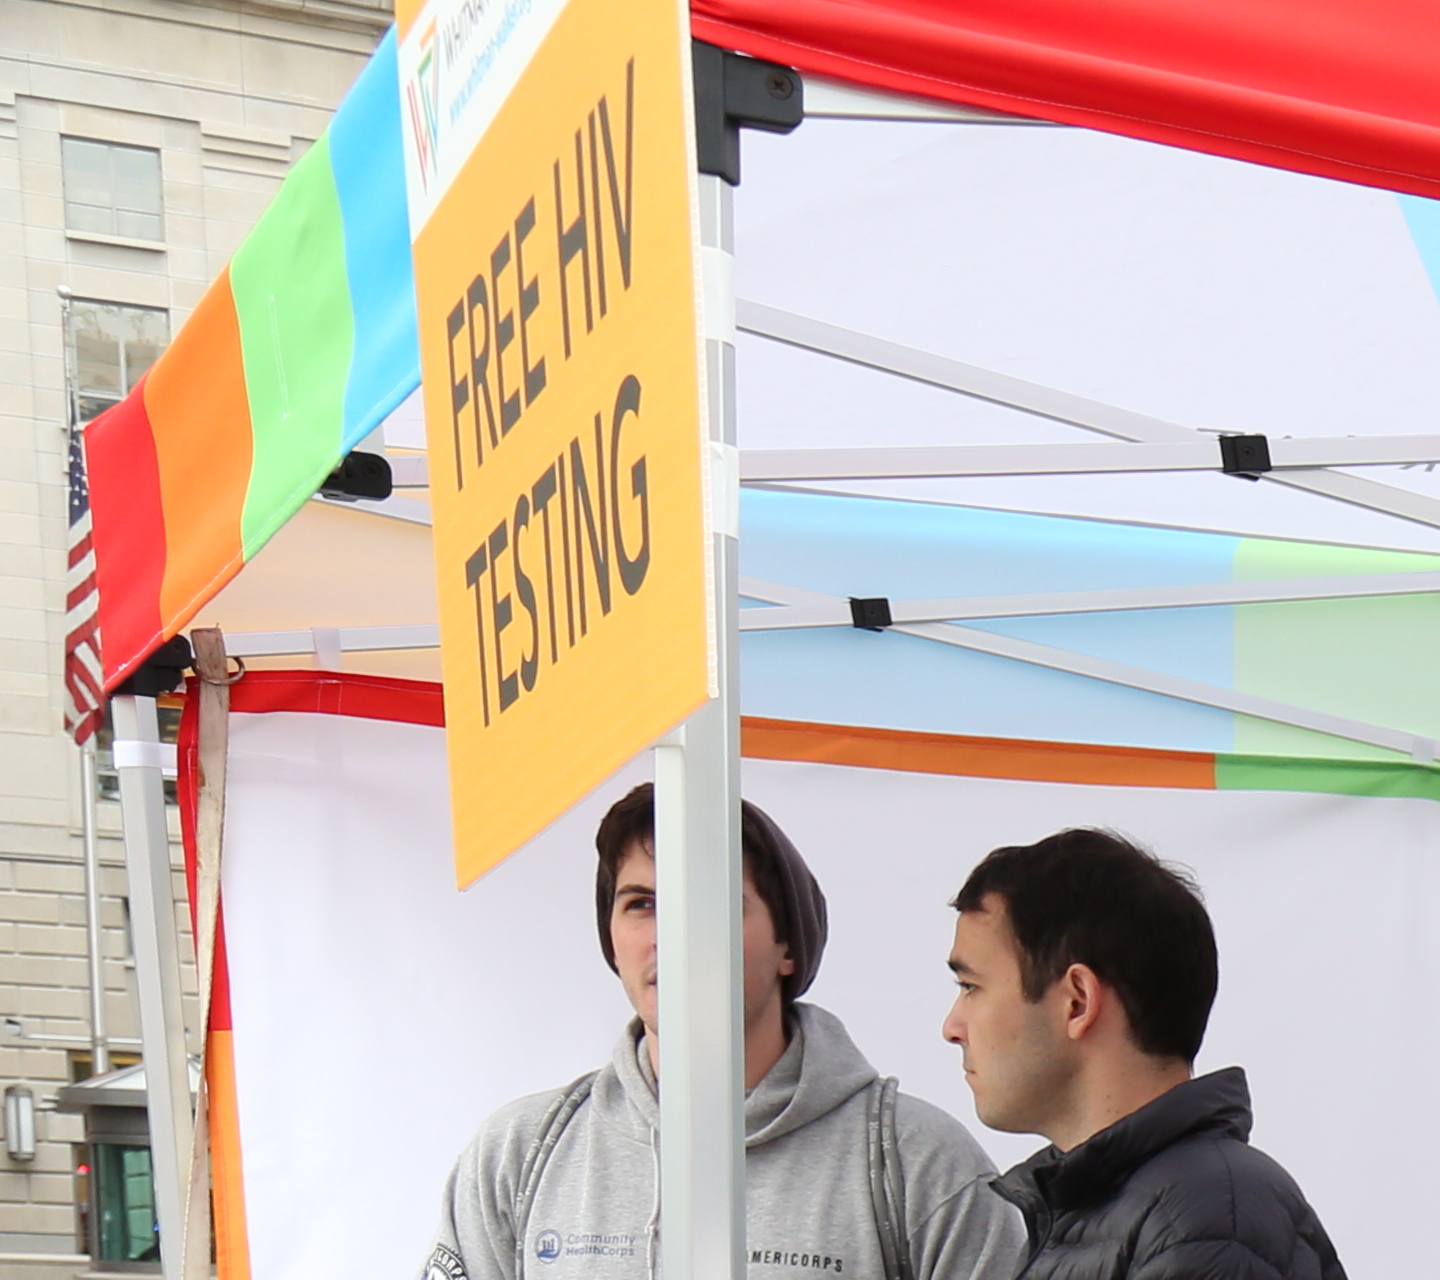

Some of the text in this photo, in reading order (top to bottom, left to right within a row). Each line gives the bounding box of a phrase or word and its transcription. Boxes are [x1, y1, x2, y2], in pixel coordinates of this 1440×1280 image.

[446, 195, 547, 492] FREE
[553, 56, 635, 359] HIV
[465, 374, 650, 727] TESTING
[566, 1245, 634, 1257] HealthCorps
[567, 1234, 636, 1245] Community
[746, 1250, 843, 1273] MERICORPS
